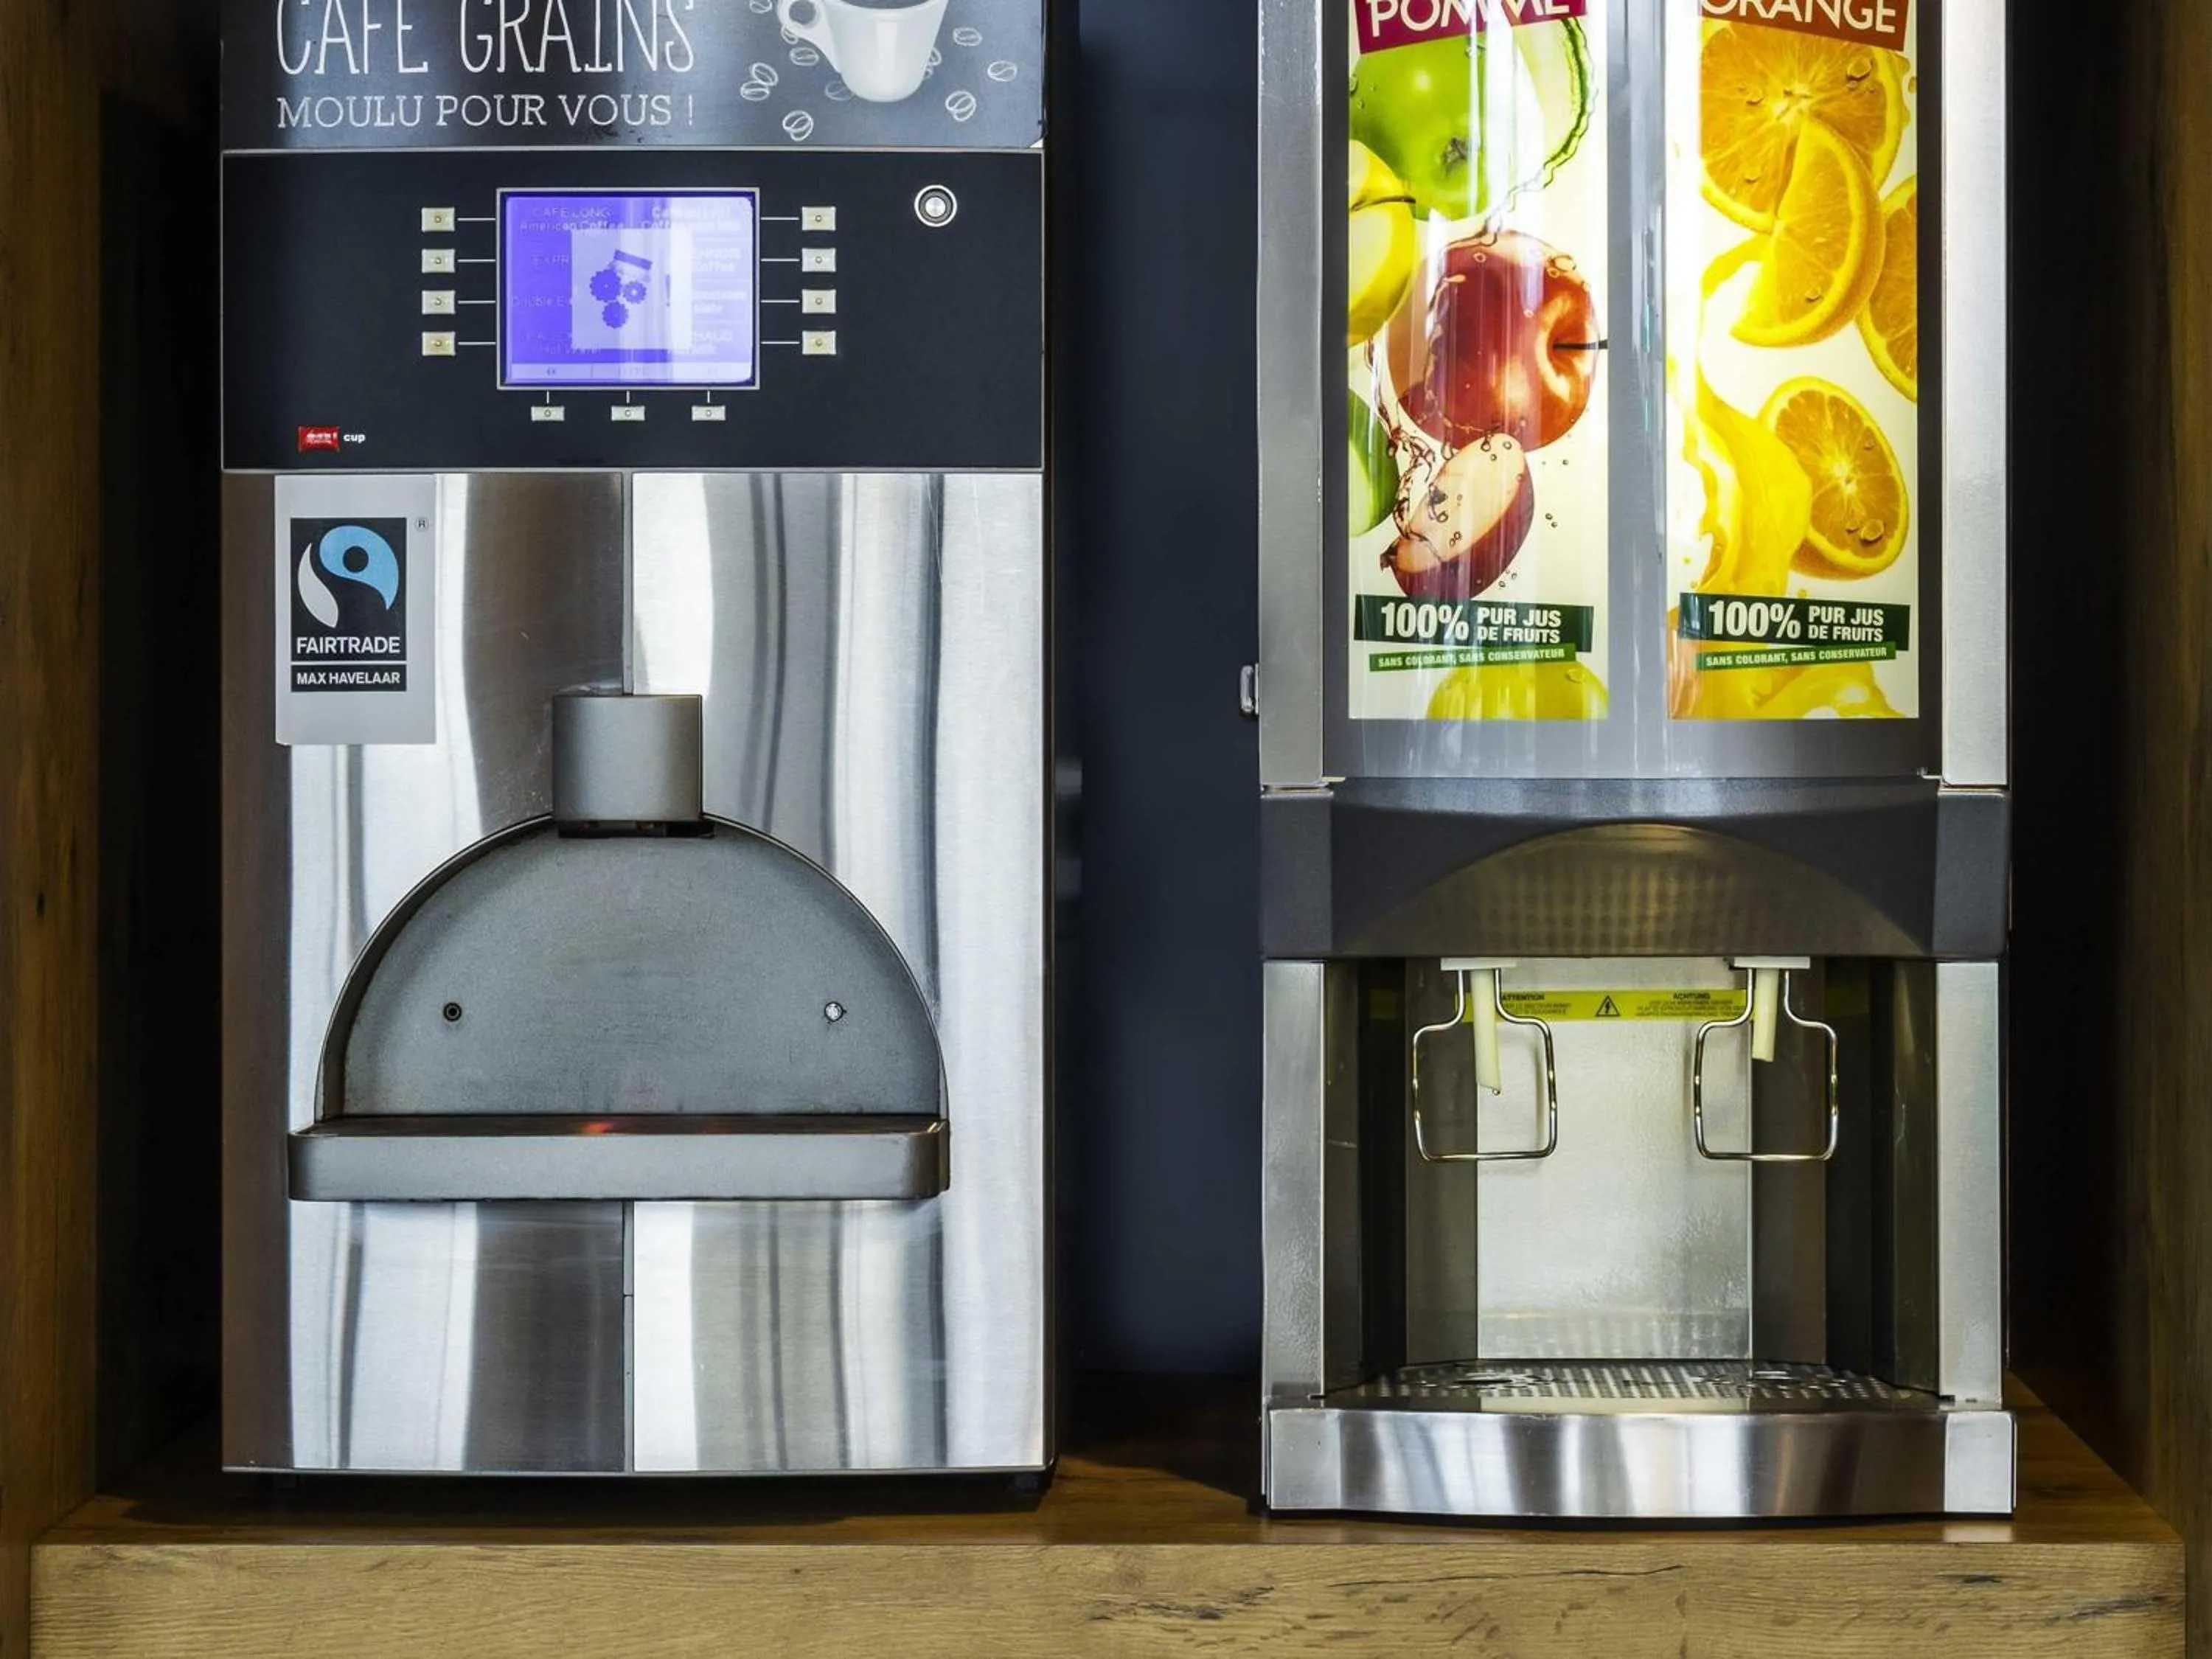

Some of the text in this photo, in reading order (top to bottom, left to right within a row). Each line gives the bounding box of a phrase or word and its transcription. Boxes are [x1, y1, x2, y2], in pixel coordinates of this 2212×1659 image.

[460, 0, 694, 72] GRAINS
[276, 94, 693, 128] MOULU POUR VOUS !
[343, 434, 366, 445] cup
[1380, 602, 1470, 641] 100%
[1476, 606, 1562, 628] PUR JUS
[1708, 599, 1801, 639] 100%
[1808, 605, 1885, 627] PUR JUS
[1476, 627, 1561, 644] DE FRUITS
[1808, 627, 1884, 642] DE FRUITS
[296, 636, 400, 654] FAIRTRADE
[1378, 657, 1402, 667] SANS
[1459, 652, 1485, 663] SANS
[1488, 648, 1565, 661] CONSERVATEUR
[1705, 647, 1888, 667] SANS COLORANT, SANS CONSERVATEUR
[296, 672, 400, 685] MAX HAVELAAR
